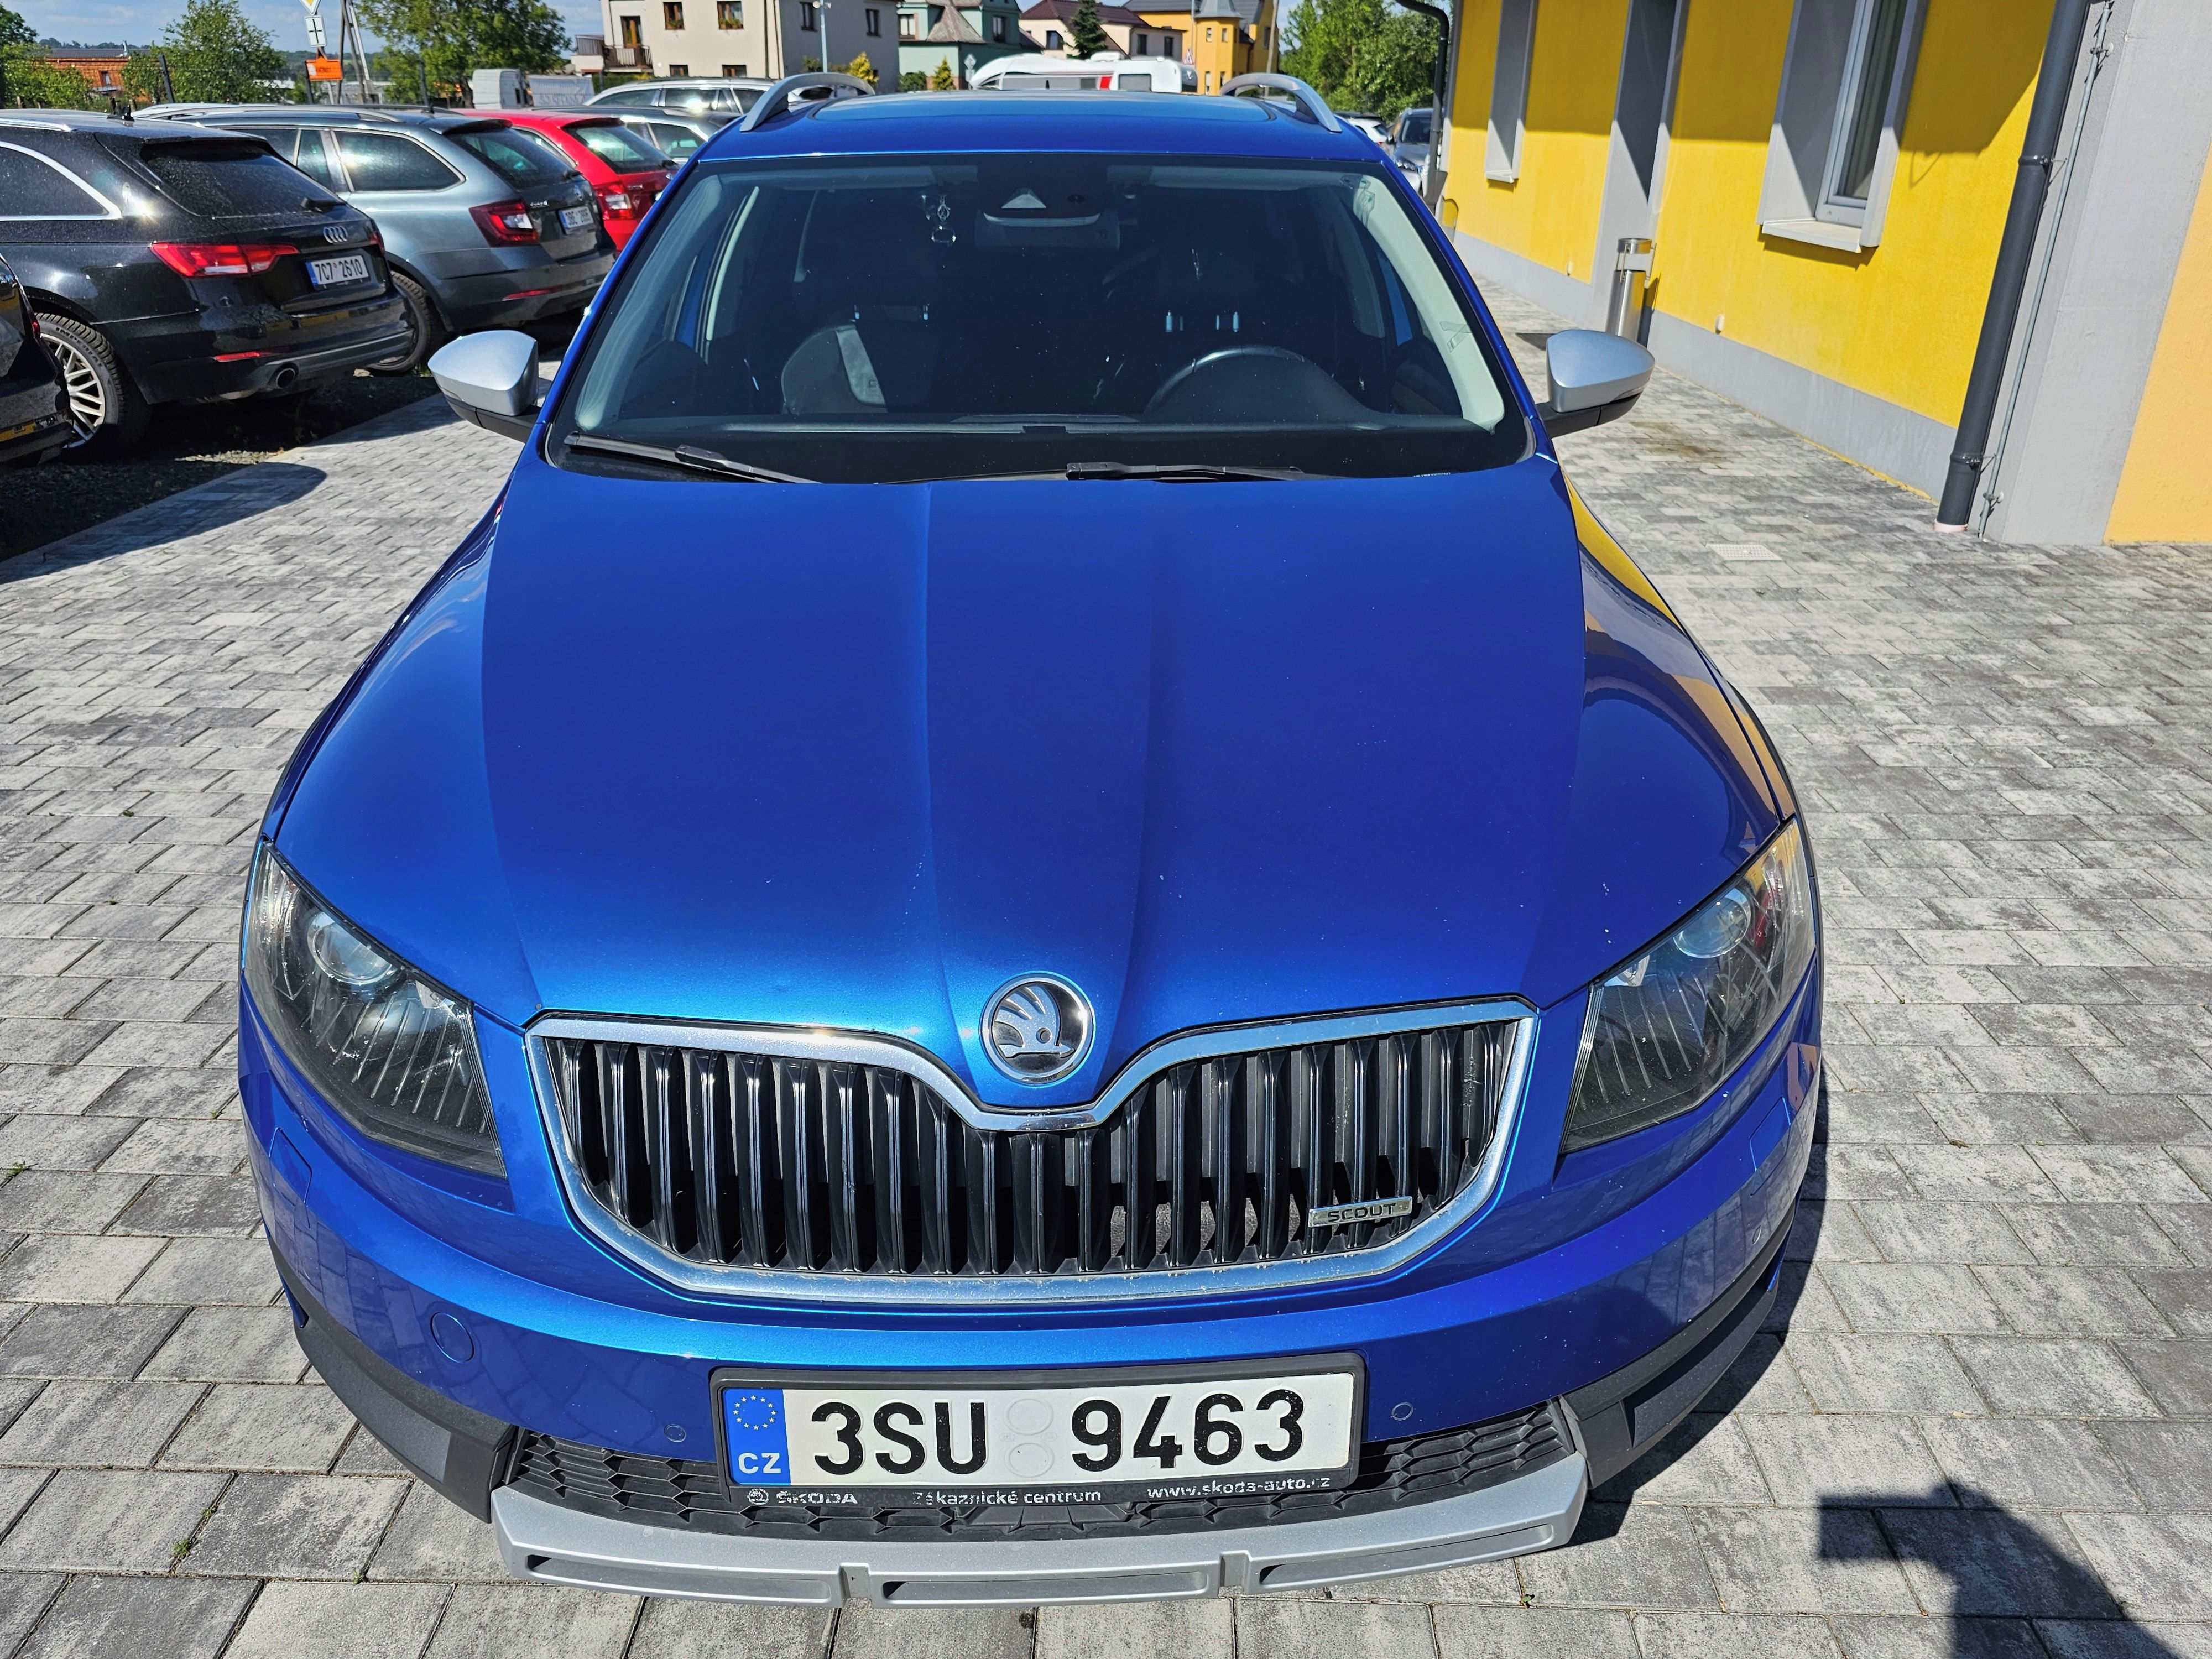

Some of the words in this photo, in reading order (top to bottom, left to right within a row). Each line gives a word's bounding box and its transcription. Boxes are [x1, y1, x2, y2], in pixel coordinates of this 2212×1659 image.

[314, 262, 333, 281] 7C7
[338, 258, 363, 278] 2610
[1328, 1203, 1396, 1223] SCOUT
[811, 1401, 987, 1475] 3SU
[1072, 1389, 1304, 1472] 9463
[738, 1452, 781, 1474] CZ
[776, 1490, 858, 1504] ŠKODA
[1024, 1490, 1102, 1504] centrum
